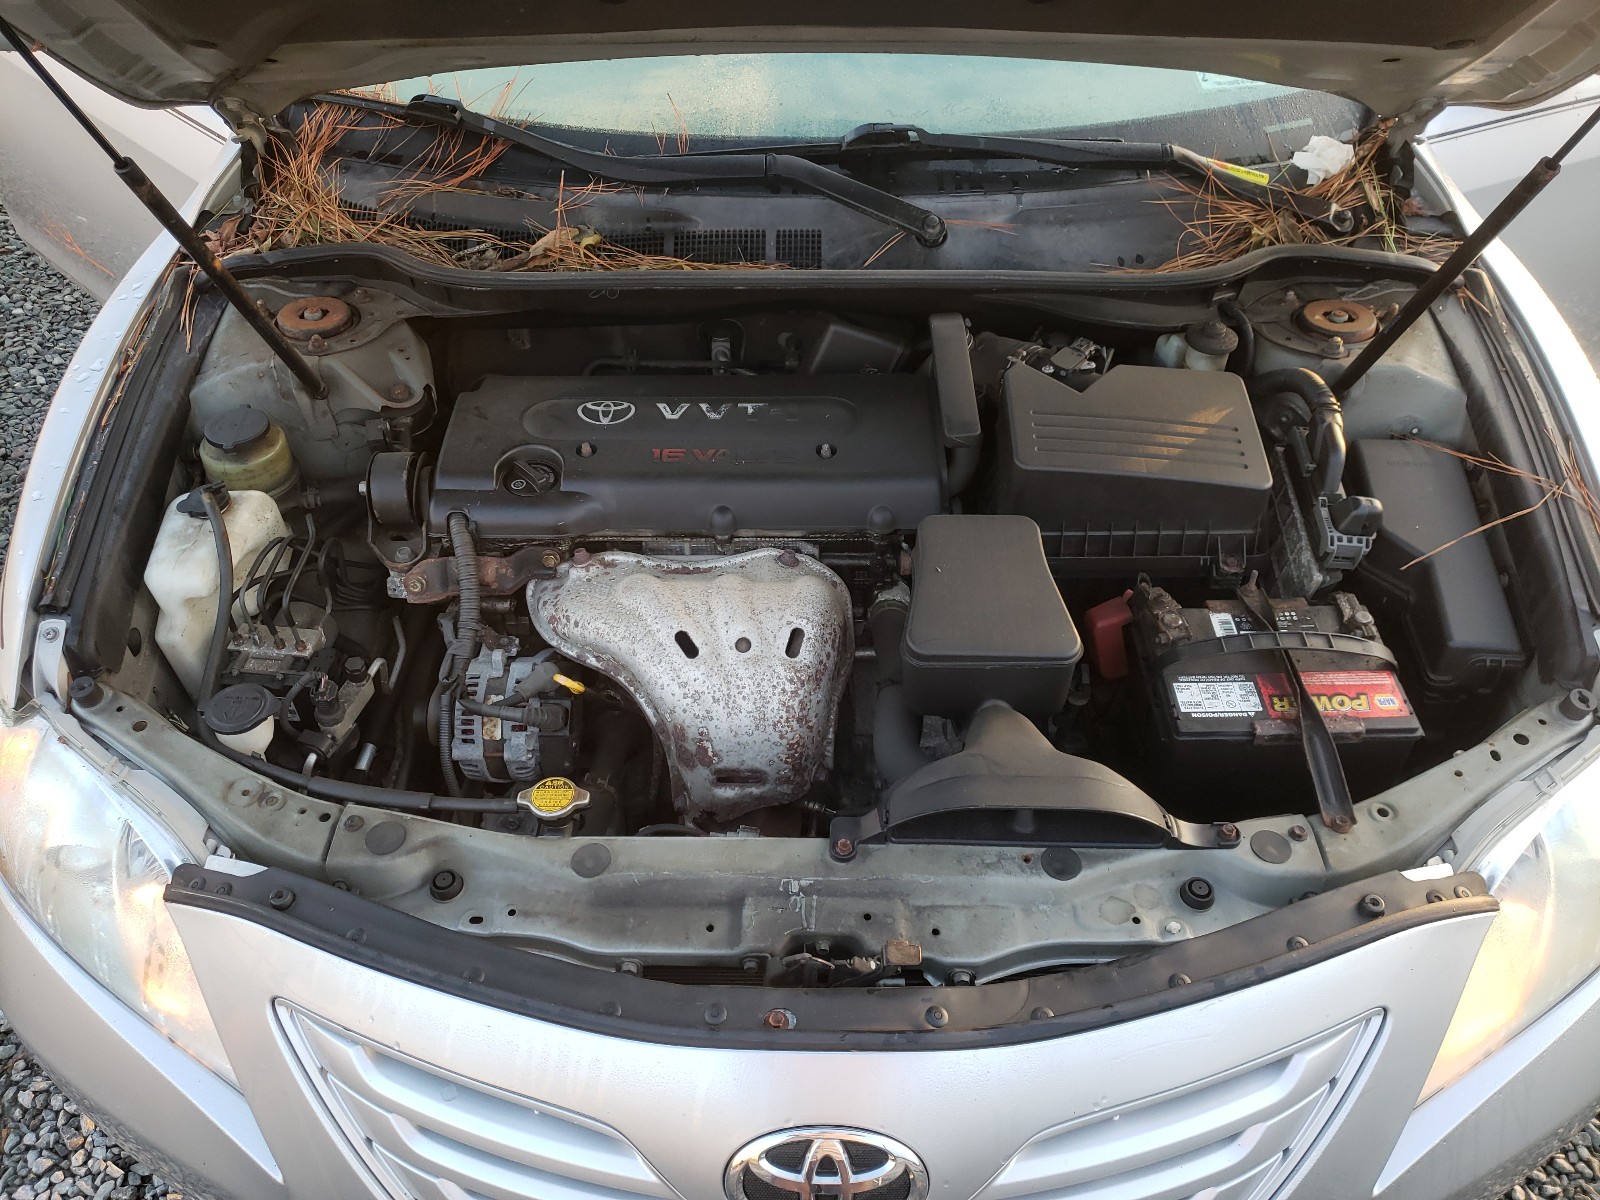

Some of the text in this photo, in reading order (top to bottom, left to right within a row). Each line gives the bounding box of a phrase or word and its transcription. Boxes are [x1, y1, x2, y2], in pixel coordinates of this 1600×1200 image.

[652, 448, 687, 462] 16
[1271, 694, 1370, 712] POWR
[1376, 697, 1397, 706] NAPA
